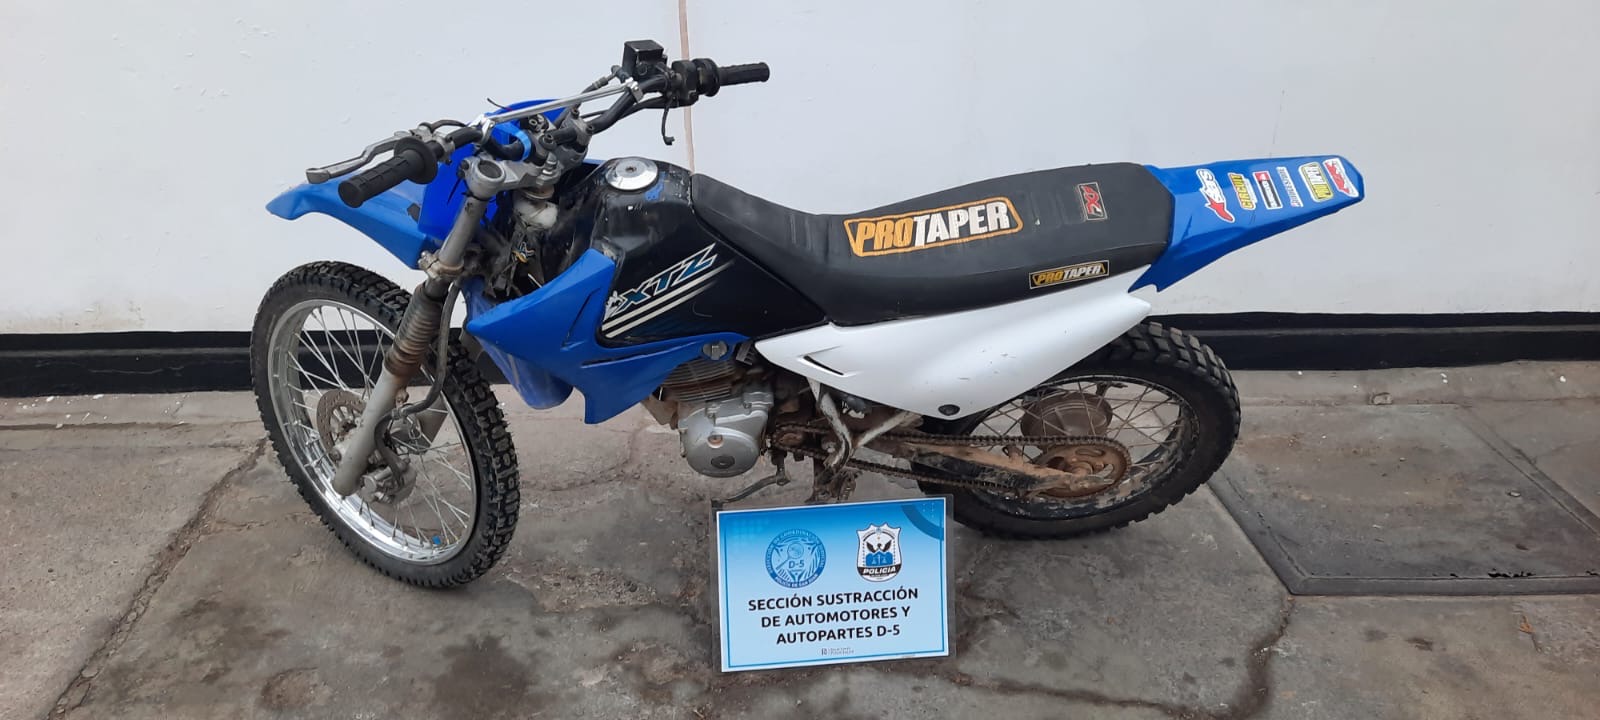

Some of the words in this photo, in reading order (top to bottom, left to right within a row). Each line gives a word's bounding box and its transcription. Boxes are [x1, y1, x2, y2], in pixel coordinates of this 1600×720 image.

[855, 201, 1011, 251] PROTAPER
[611, 242, 718, 316] XTZ
[1033, 263, 1103, 286] PROTAPER
[788, 560, 805, 569] D-5
[748, 593, 812, 611] SECCIÓN
[816, 586, 918, 605] SUSTRACCIÓN
[761, 615, 781, 628] DE
[785, 607, 897, 626] AUTOMOTORES
[901, 606, 910, 617] Y
[776, 626, 872, 644] AUTOPARTES
[876, 624, 900, 637] D-5
